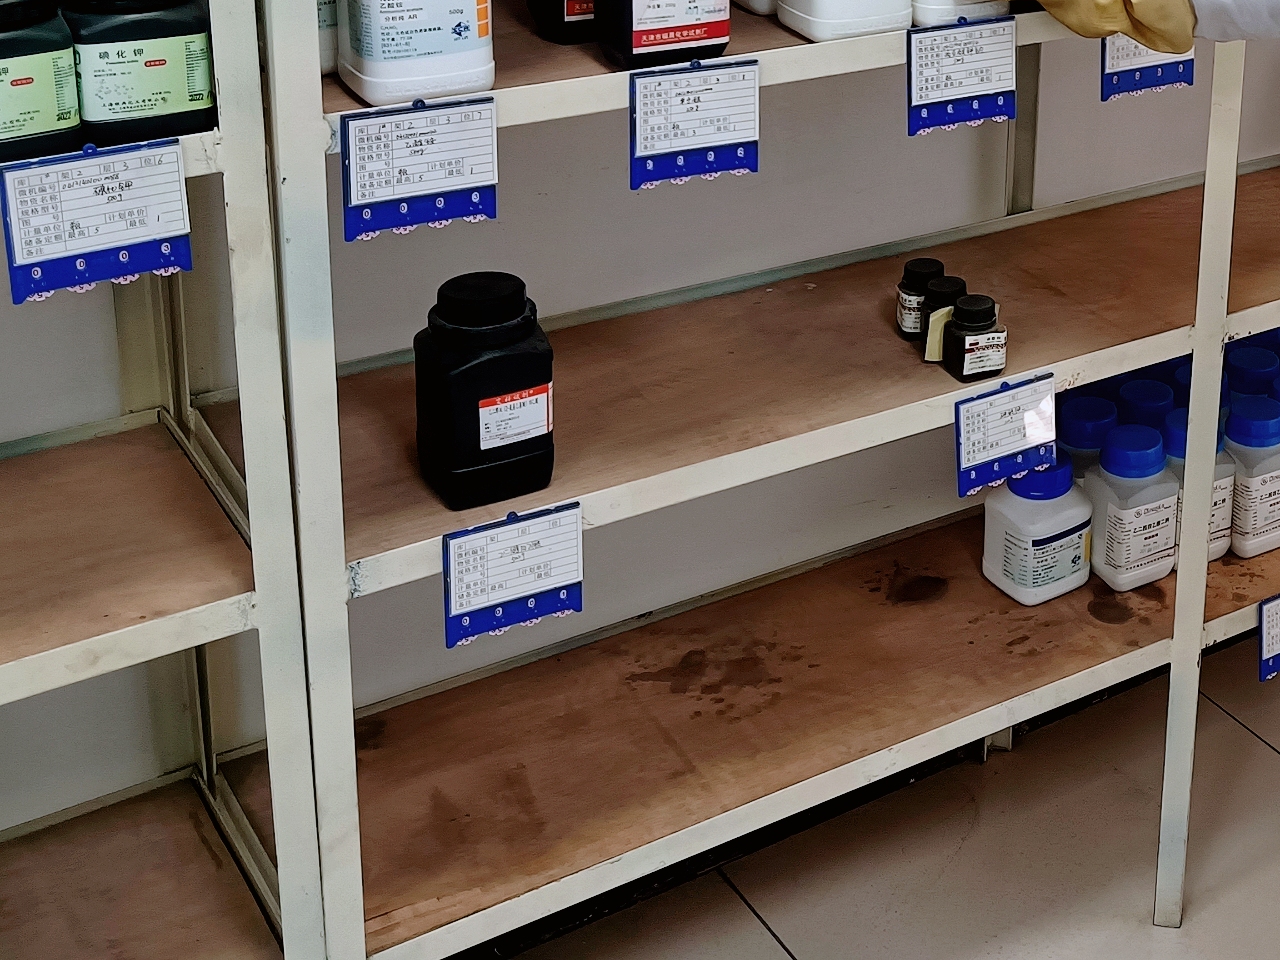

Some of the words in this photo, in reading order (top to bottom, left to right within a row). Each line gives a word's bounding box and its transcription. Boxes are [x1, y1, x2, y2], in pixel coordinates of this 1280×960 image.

[99, 48, 144, 60] 碘化钾
[123, 162, 129, 170] 3
[158, 155, 164, 165] 6
[359, 170, 391, 180] 计量单位
[430, 160, 461, 170] 计划单价
[18, 183, 57, 197] 微机编号
[19, 195, 59, 206] 物资名称
[20, 204, 59, 216] 规格型号
[23, 223, 62, 236] 计量单位
[108, 209, 144, 222] 计划单价
[24, 234, 63, 246] 储备定额
[68, 231, 86, 239] 最高
[129, 219, 148, 227] 最低
[25, 248, 45, 257] 备注
